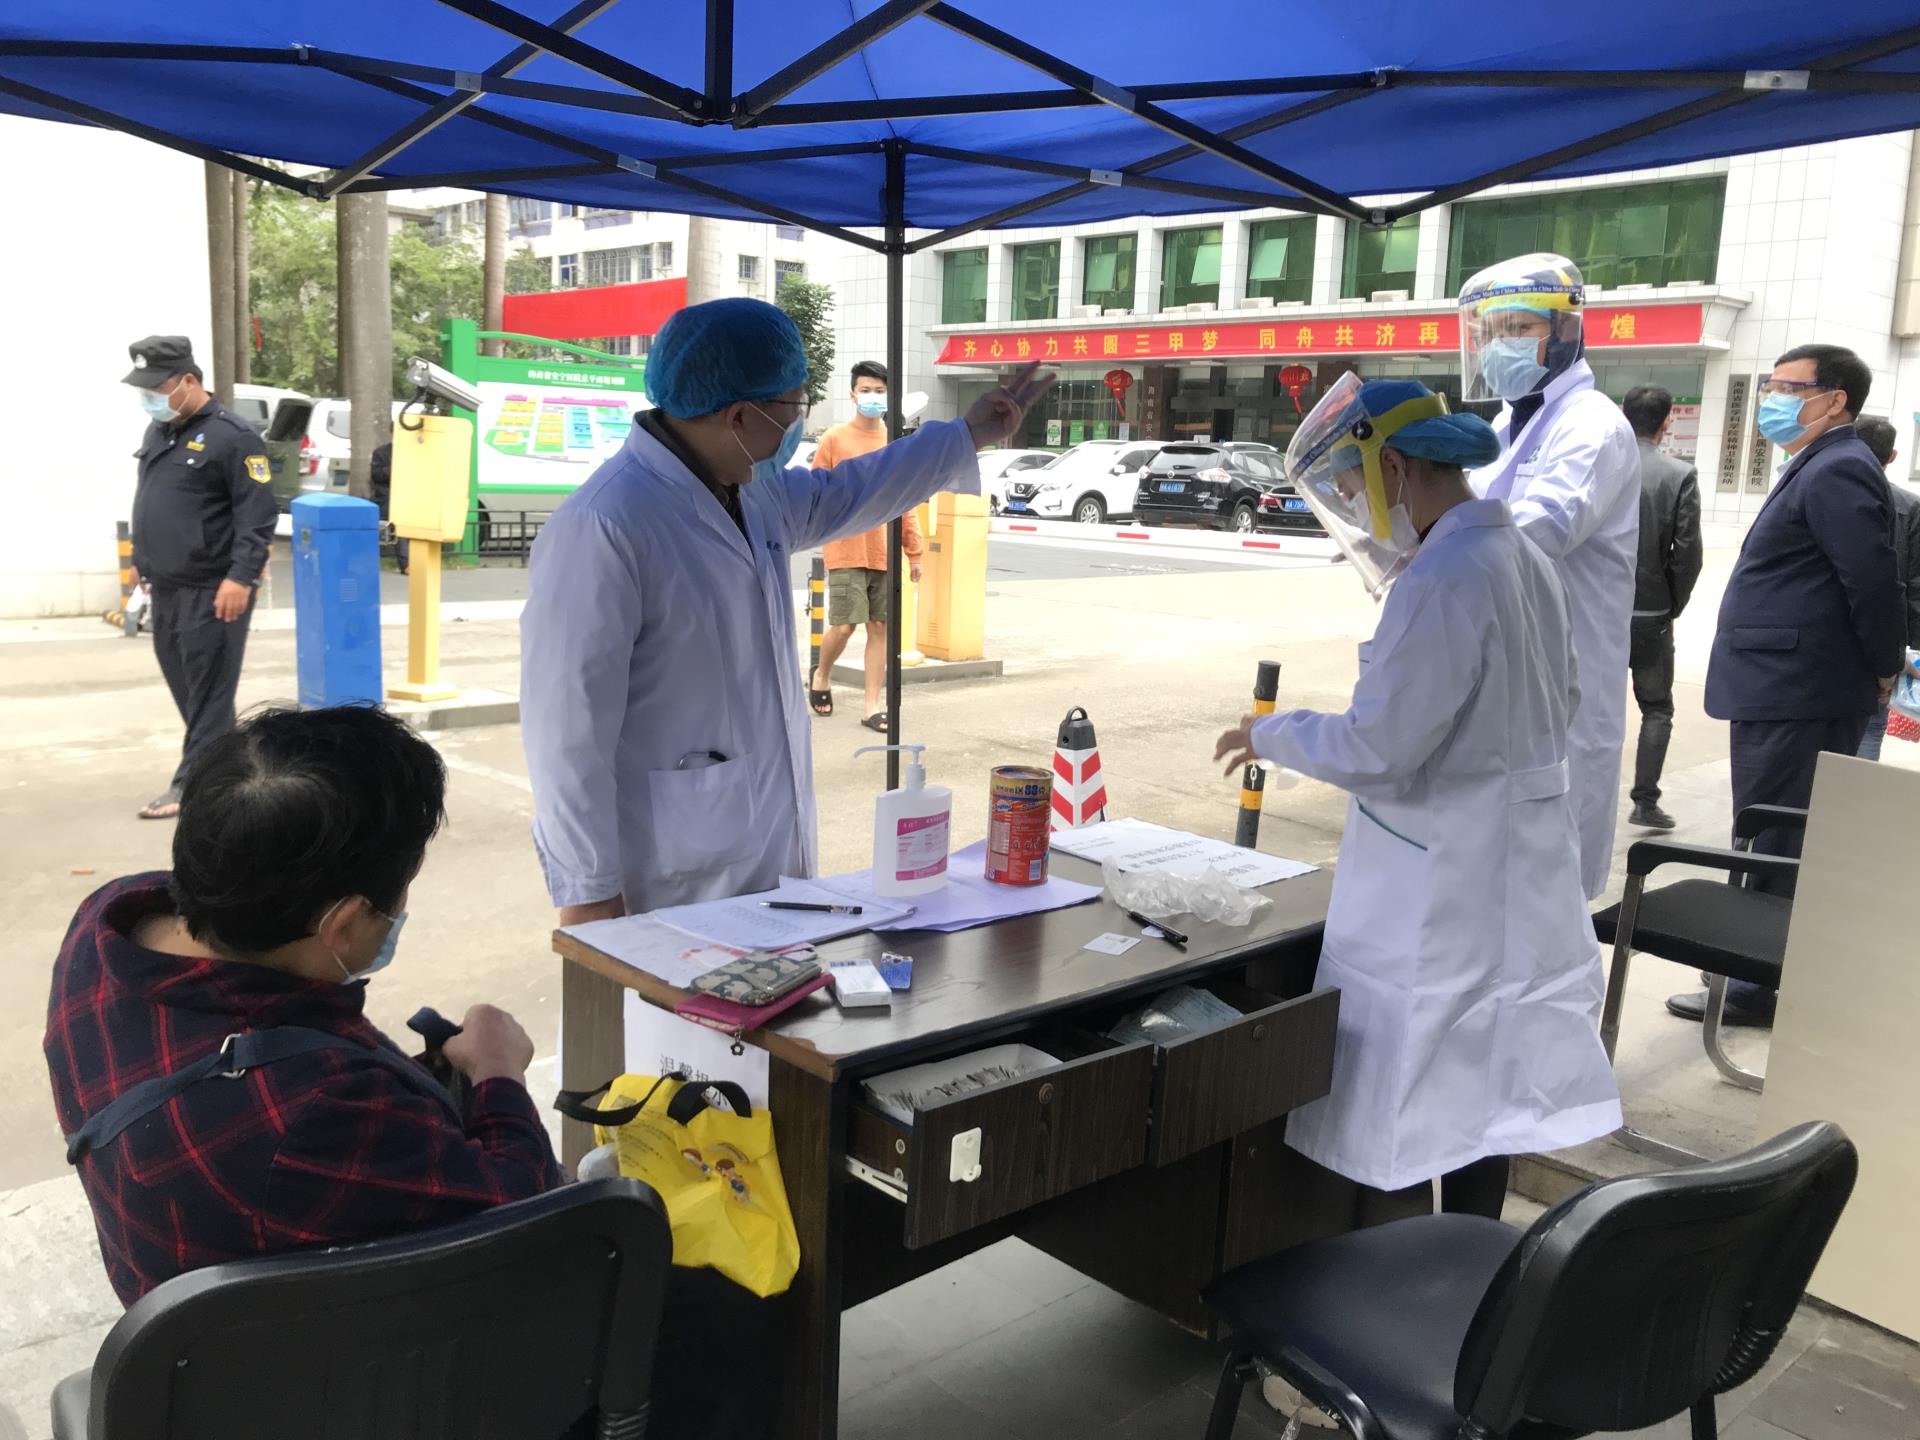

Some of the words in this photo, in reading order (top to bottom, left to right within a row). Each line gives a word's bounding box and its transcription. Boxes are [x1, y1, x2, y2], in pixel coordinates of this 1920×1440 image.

[1259, 312, 1635, 350] 同舟共济再煌
